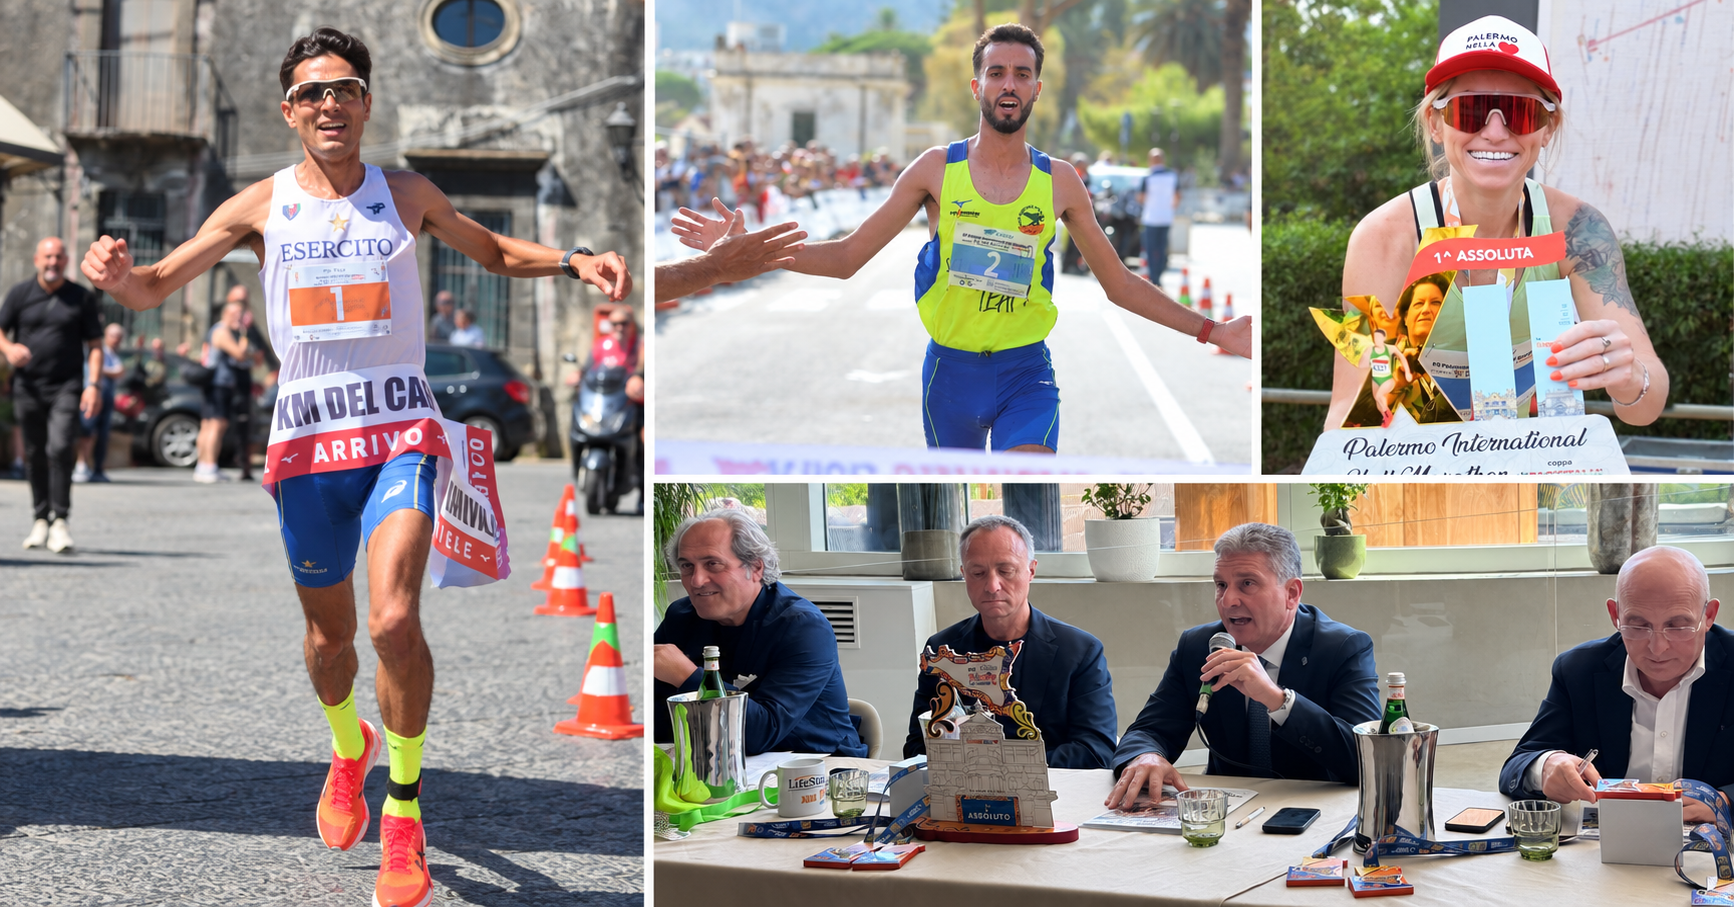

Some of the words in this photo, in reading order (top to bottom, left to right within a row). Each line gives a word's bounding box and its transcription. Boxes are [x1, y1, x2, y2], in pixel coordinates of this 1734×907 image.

[1465, 41, 1496, 50] NELLA
[1466, 32, 1518, 43] PALERMO
[280, 238, 393, 262] ESERCITO
[1456, 246, 1534, 262] ASSOLUTA
[983, 251, 1001, 278] 2
[329, 286, 345, 322] 1
[276, 390, 322, 431] KM
[323, 381, 379, 421] DEL
[313, 427, 423, 464] ARRIVO
[1342, 436, 1436, 460] Palermo
[1441, 427, 1588, 457] International
